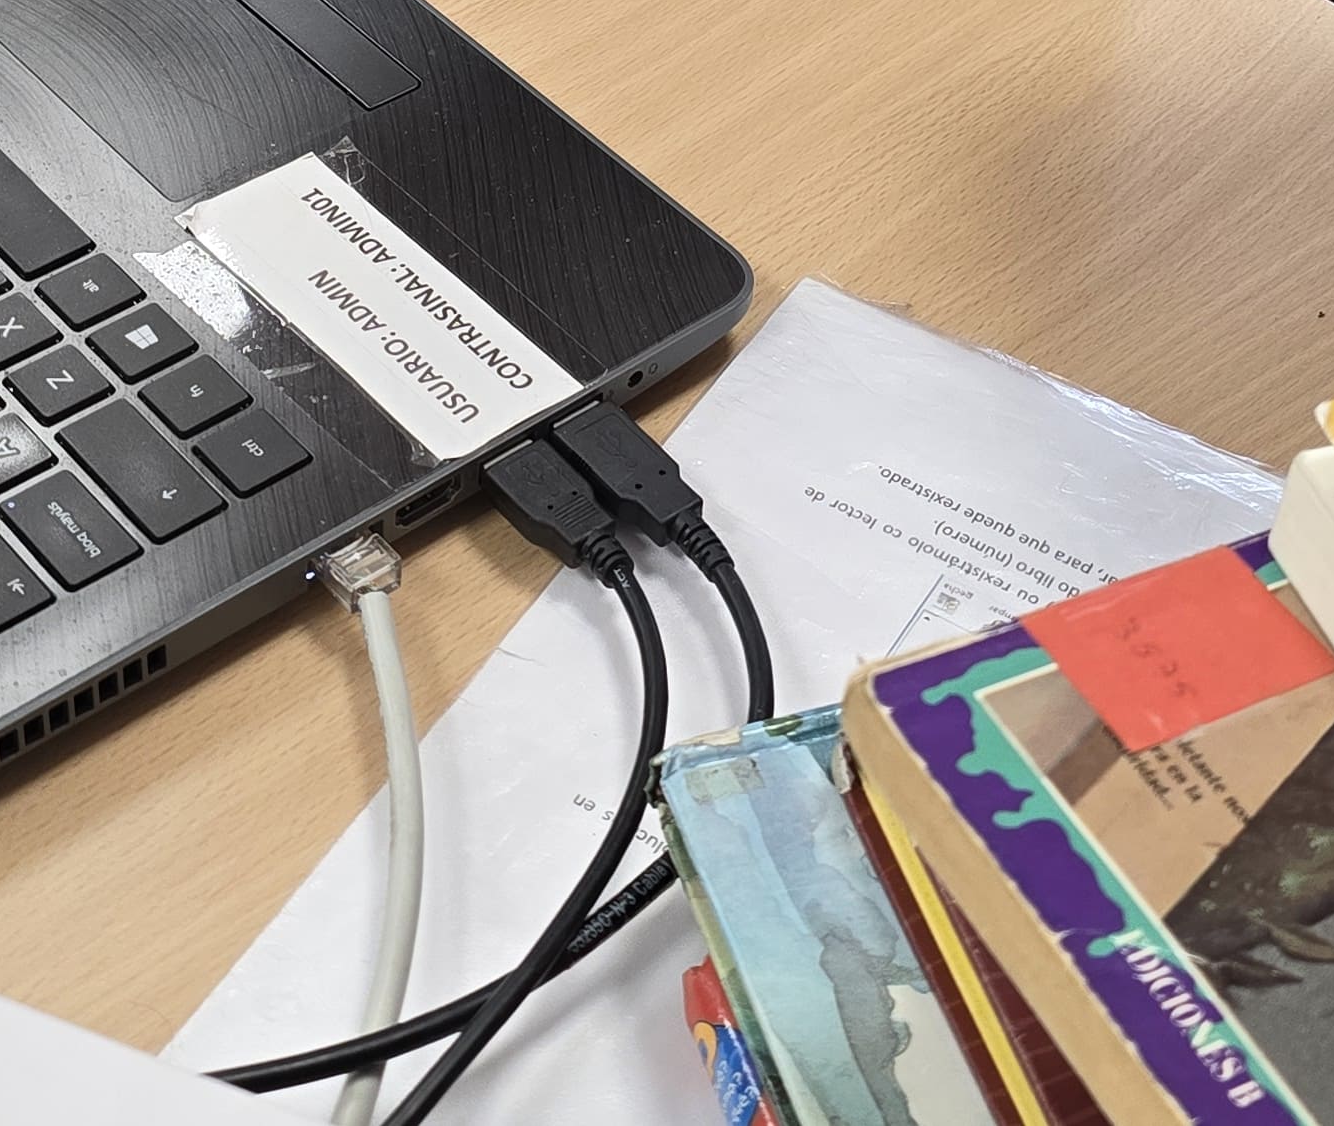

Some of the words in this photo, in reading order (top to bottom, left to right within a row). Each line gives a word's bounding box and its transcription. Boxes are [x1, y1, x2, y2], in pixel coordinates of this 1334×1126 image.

[301, 187, 397, 265] ADMIN01
[308, 269, 388, 332] ADMIN
[390, 263, 534, 389] CONTRASINAL:
[45, 369, 75, 390] Z
[380, 331, 480, 424] USUARIO:
[240, 438, 265, 457] ctrl
[804, 485, 826, 503] de
[878, 464, 962, 512] rexistrado.
[829, 498, 878, 530] lector
[963, 507, 1016, 539] quede
[76, 532, 101, 559] bloq
[882, 523, 903, 539] co
[933, 519, 1014, 567] (número).
[1018, 531, 1051, 555] que
[908, 535, 1013, 592] rexistrámolo
[1016, 561, 1055, 590] libro
[1054, 550, 1094, 575] para
[1017, 589, 1040, 605] ou
[1113, 929, 1245, 1082] EDICIONES
[1227, 1080, 1266, 1108] B
